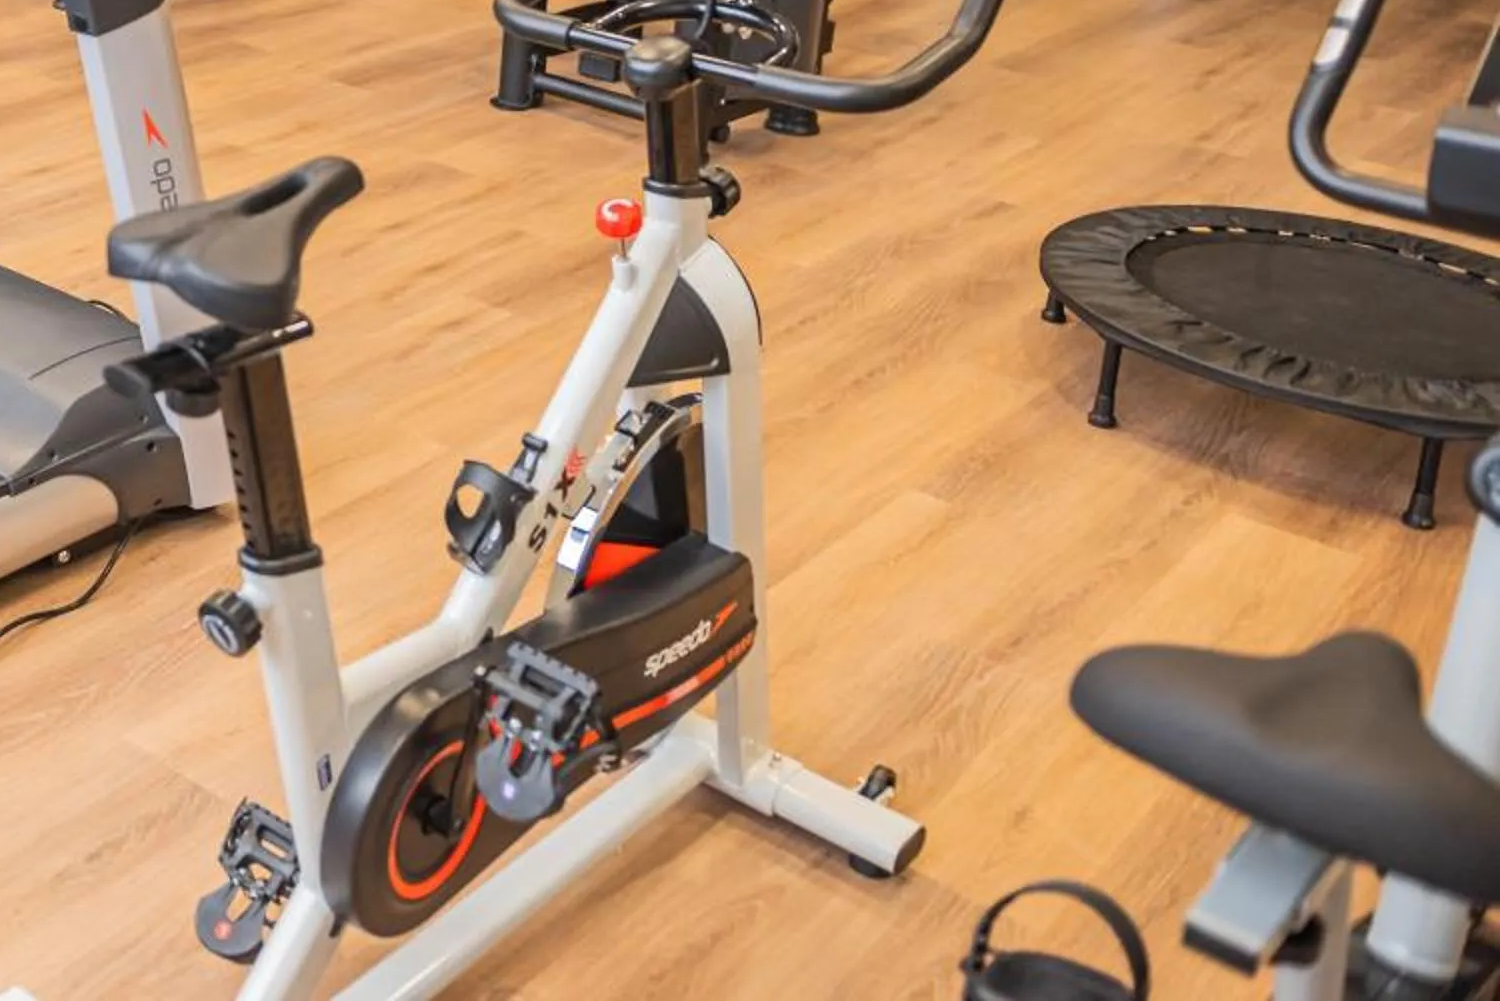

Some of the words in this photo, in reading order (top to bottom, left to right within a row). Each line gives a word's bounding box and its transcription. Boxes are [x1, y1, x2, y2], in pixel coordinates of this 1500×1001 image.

[150, 158, 179, 212] edo
[528, 469, 576, 553] S1X
[644, 619, 712, 678] speedo
